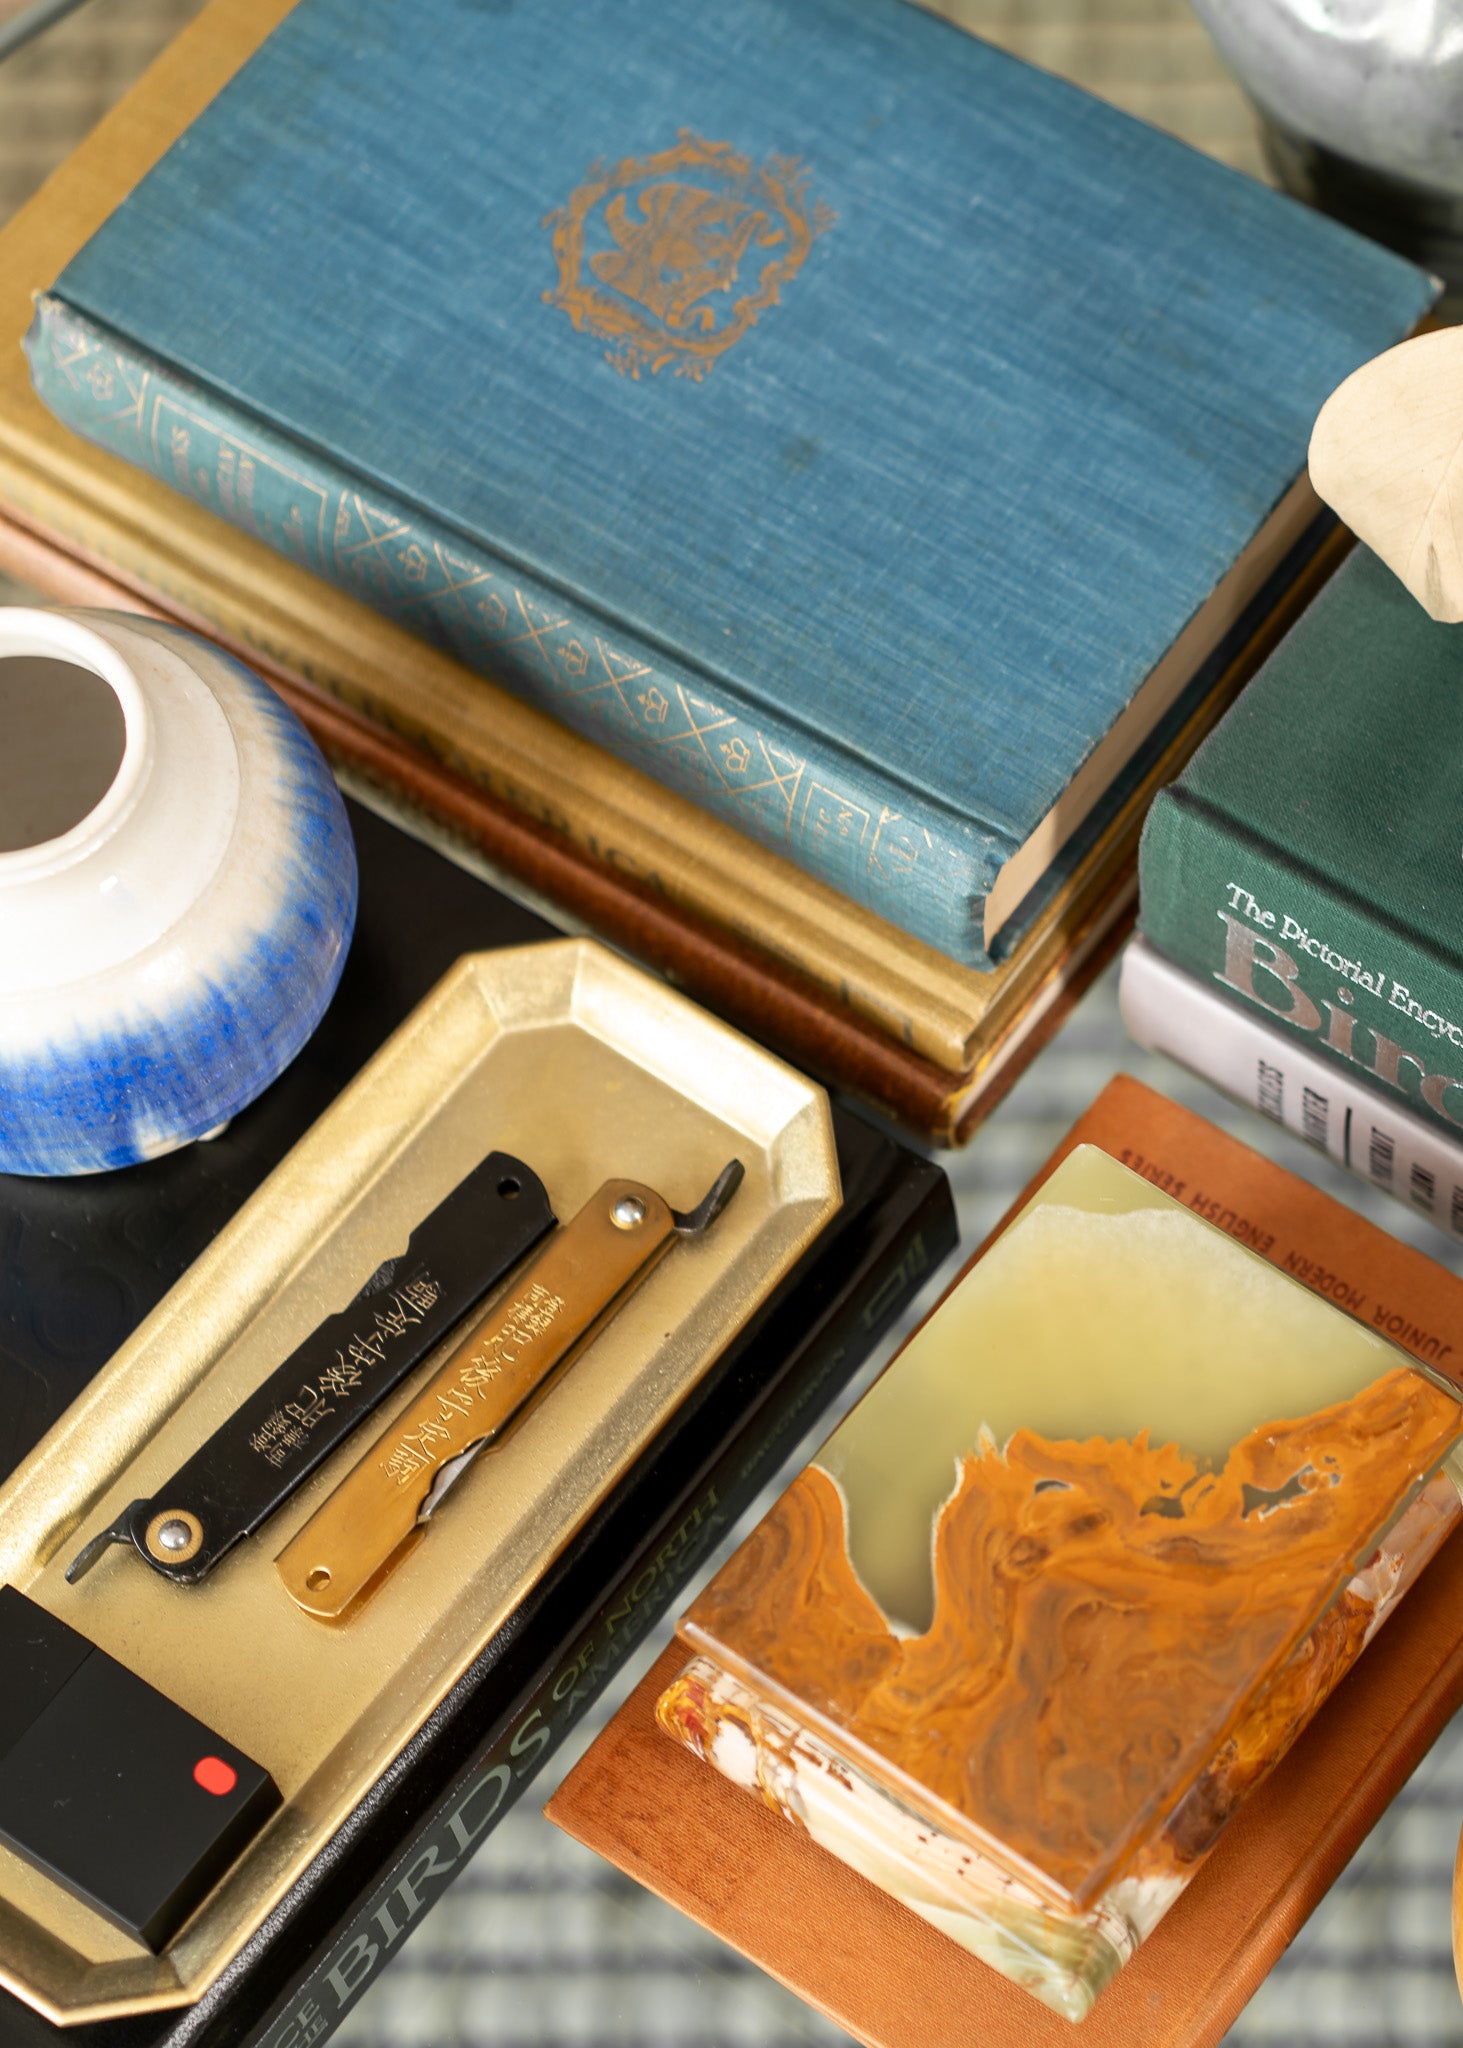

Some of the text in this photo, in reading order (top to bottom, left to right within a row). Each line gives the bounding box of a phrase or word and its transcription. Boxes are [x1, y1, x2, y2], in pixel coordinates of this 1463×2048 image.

[1226, 882, 1276, 930] The
[1279, 914, 1386, 998] Pictorial
[1189, 1191, 1277, 1255] ENGLISH
[1284, 1250, 1366, 1312] MODERN
[1373, 1304, 1453, 1360] JUNIOR
[552, 1487, 719, 1701] OF NORTH
[566, 1515, 726, 1716] AMERICA
[322, 1708, 551, 2010] BIRDS
